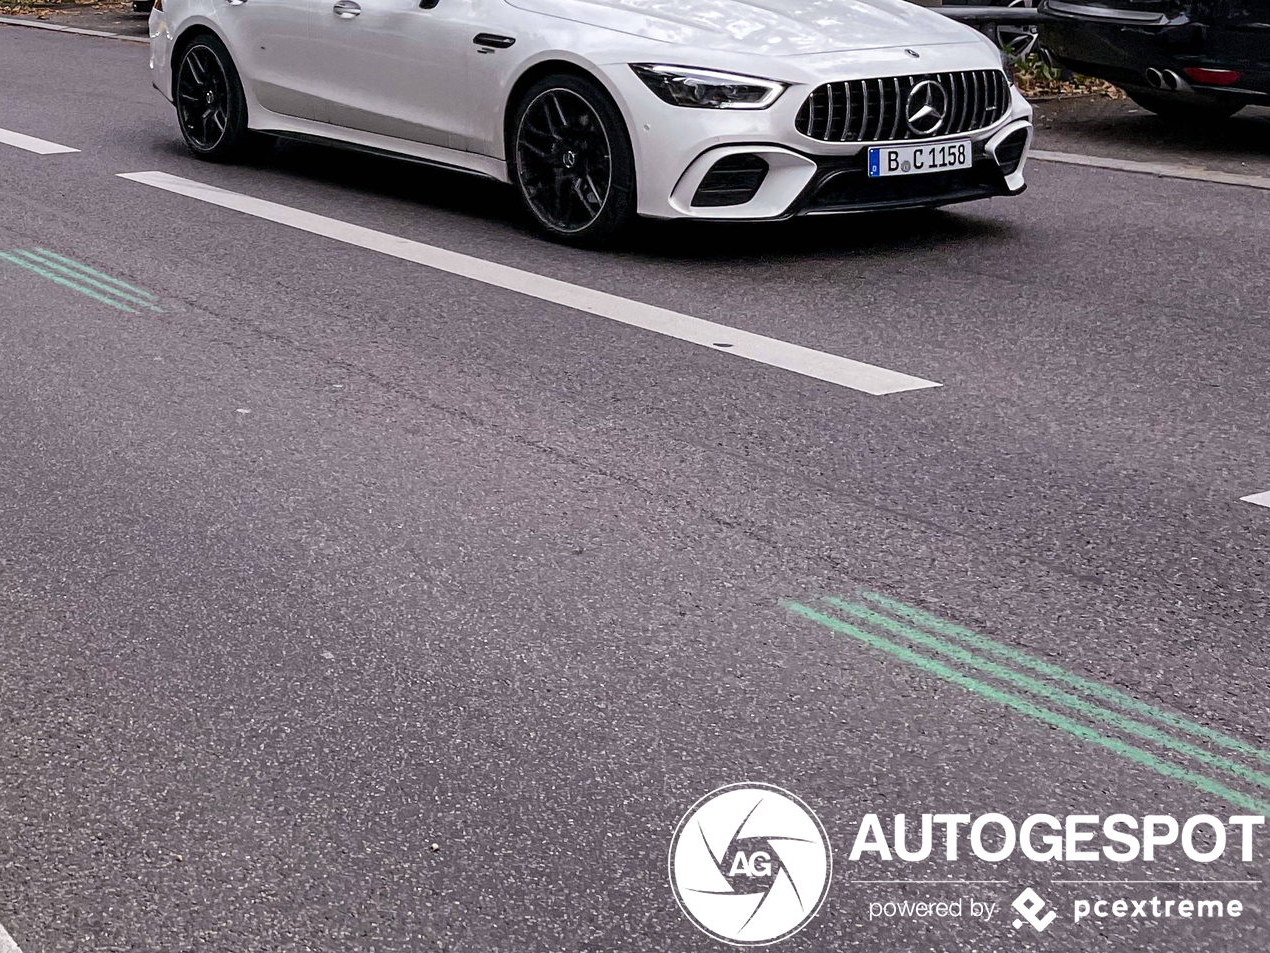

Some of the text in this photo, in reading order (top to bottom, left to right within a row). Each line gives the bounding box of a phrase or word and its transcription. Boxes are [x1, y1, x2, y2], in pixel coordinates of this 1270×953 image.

[887, 144, 966, 172] B C 1158
